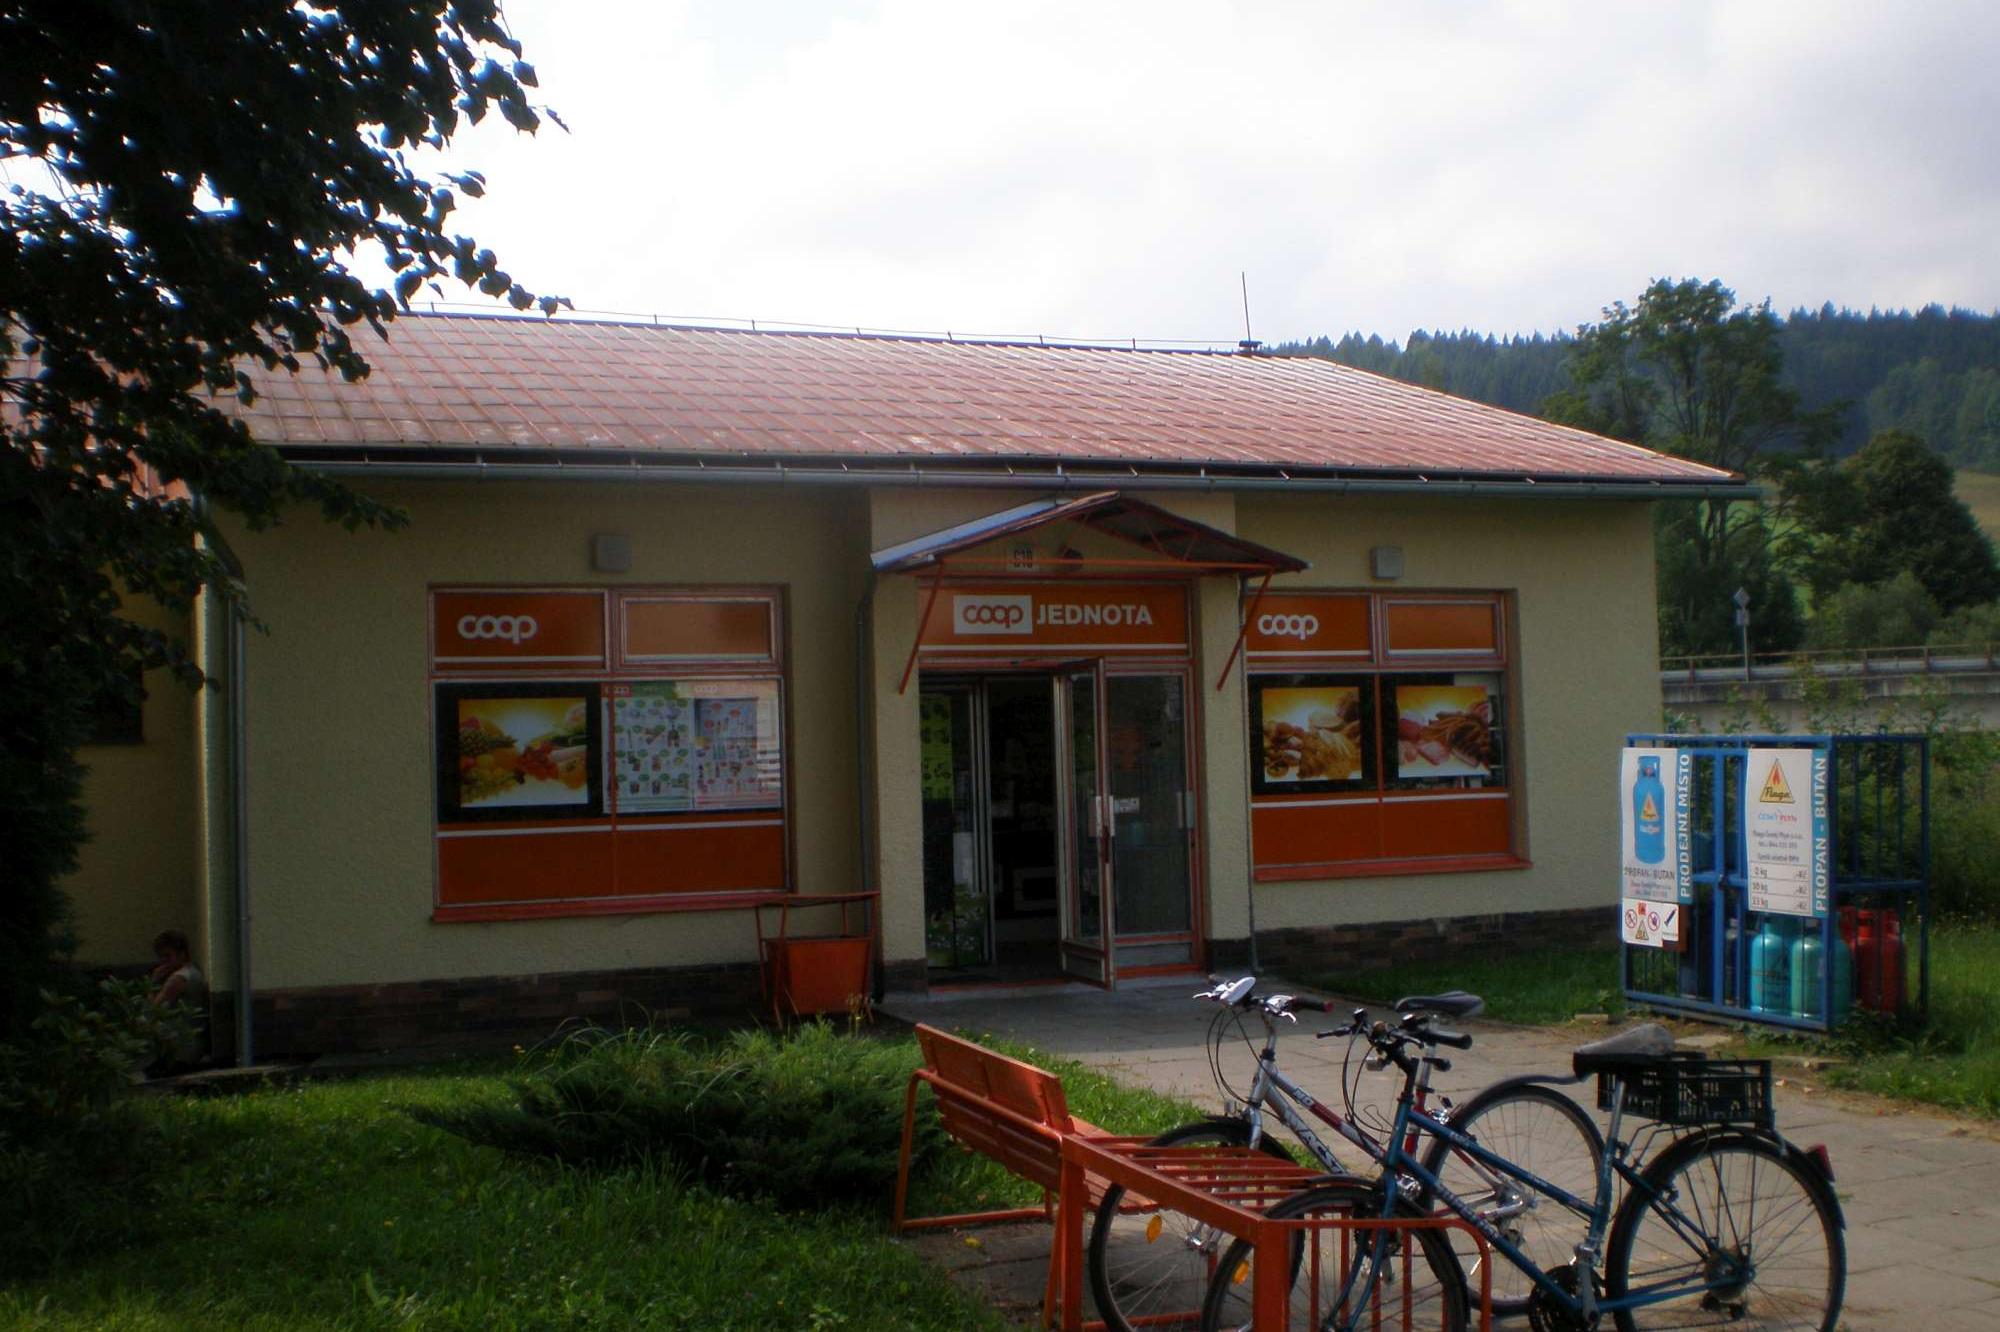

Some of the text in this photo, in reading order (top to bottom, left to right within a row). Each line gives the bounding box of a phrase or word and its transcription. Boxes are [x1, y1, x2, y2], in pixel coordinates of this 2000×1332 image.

[457, 614, 538, 644] coop
[962, 604, 1153, 629] coop JEDNOTA
[1258, 614, 1319, 640] coop
[1677, 754, 1689, 807] MÍSTO
[1814, 757, 1826, 818] BUTAN
[1815, 838, 1826, 912] PROPAN
